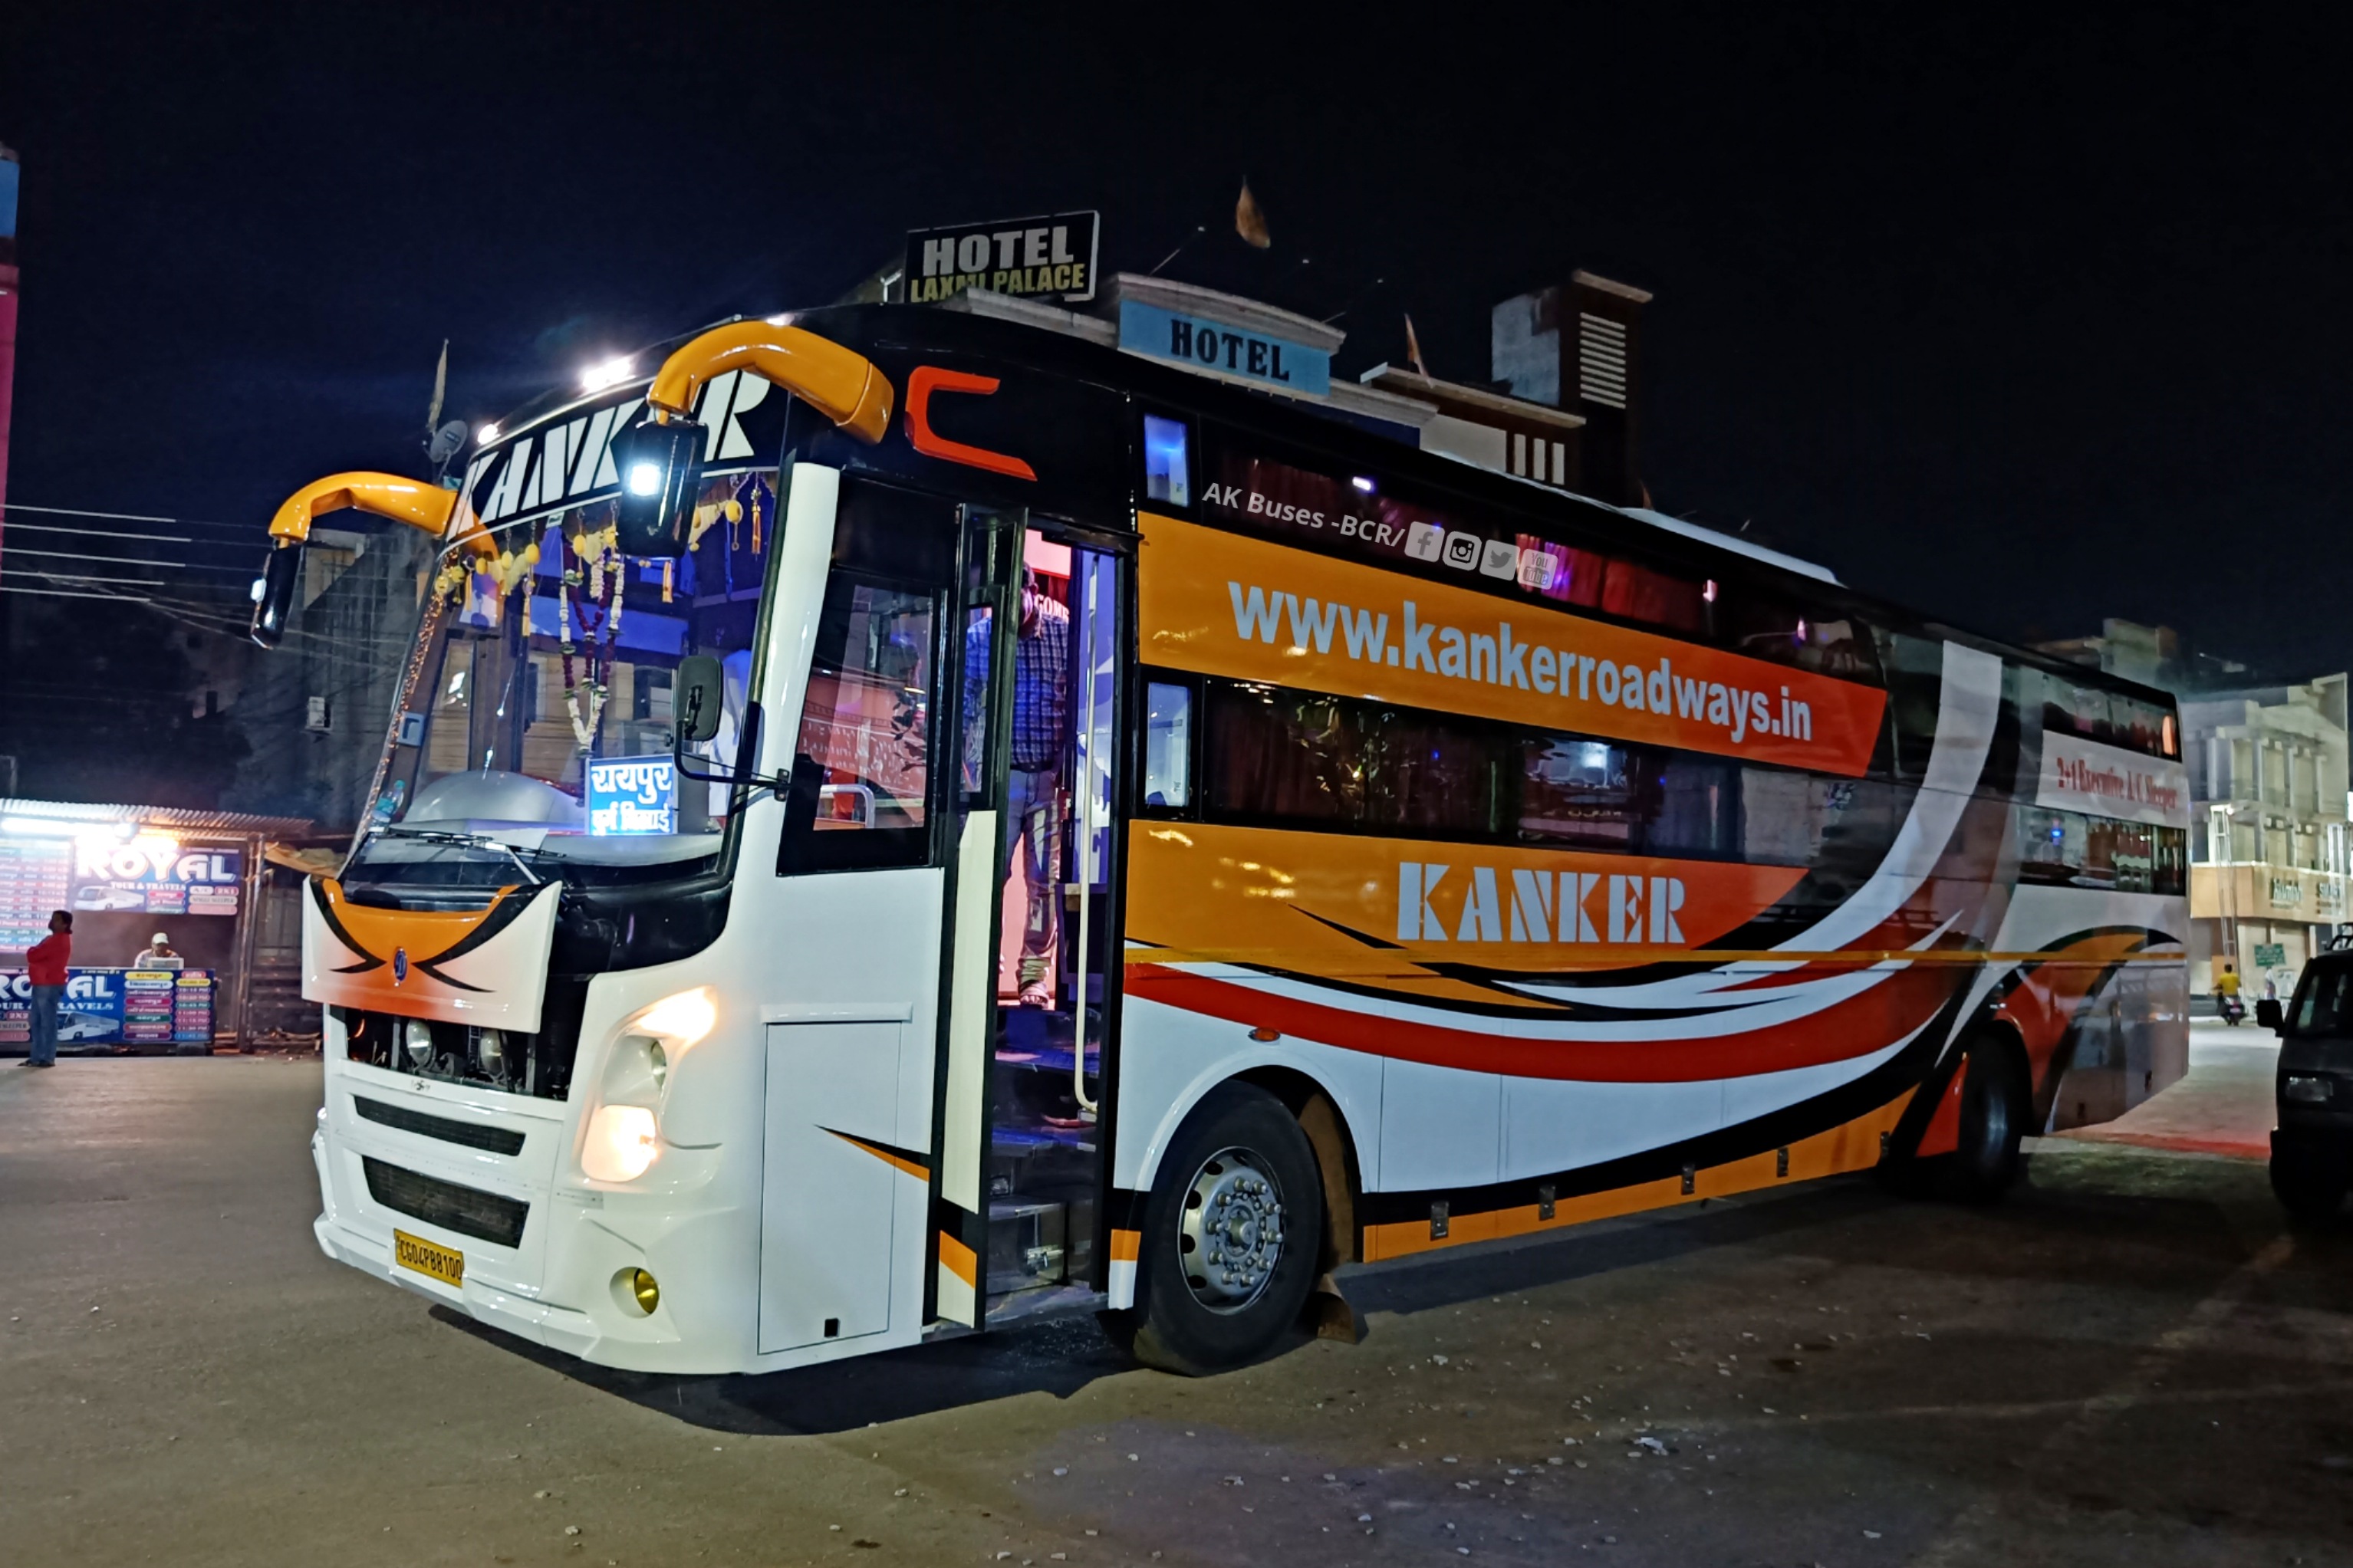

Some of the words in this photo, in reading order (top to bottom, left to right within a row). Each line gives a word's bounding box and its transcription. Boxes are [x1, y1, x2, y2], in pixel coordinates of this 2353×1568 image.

[923, 225, 1074, 277] HOTEL
[993, 263, 1085, 294] PALACE
[1170, 318, 1290, 382] HOTEL
[447, 368, 770, 542] KANKR
[1202, 482, 1242, 509] AK
[1247, 491, 1325, 529] Buses
[1228, 580, 1812, 744] www.kankerroadways.in
[591, 762, 673, 804] रायपुर
[77, 848, 236, 884] ROYAL
[146, 883, 186, 891] TRAVELS
[1397, 860, 1687, 944] KANKER
[57, 1002, 114, 1011] RAVELS
